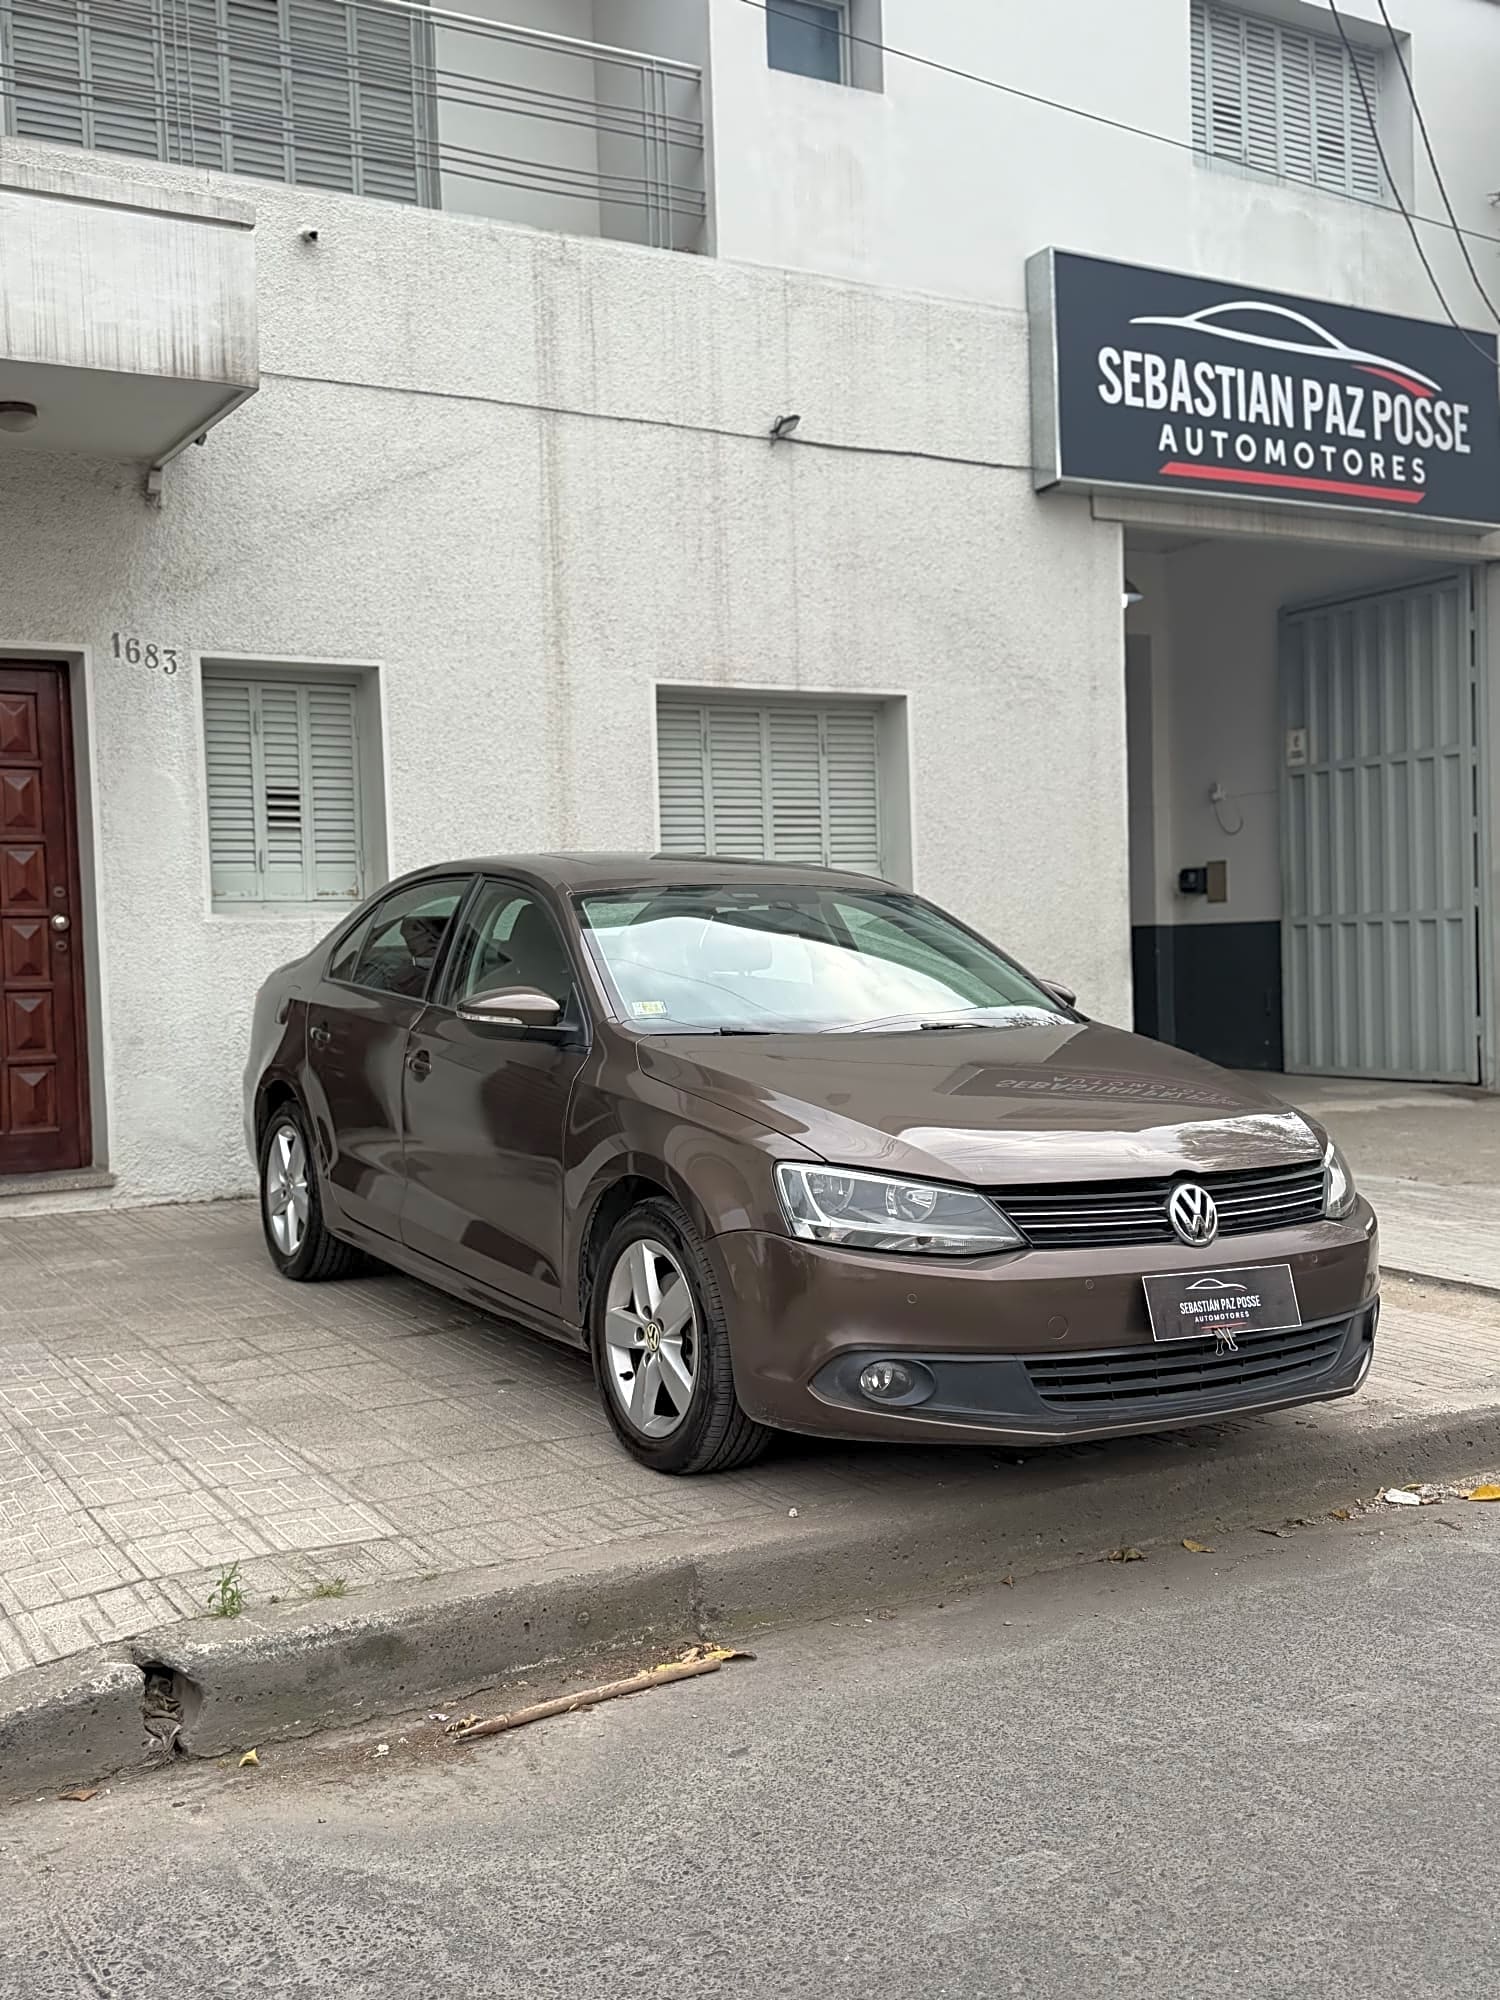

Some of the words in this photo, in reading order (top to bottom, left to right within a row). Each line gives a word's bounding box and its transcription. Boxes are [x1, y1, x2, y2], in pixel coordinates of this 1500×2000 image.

[1098, 346, 1294, 428] SEBASTIAN
[1302, 378, 1366, 438] PAZ
[1372, 390, 1471, 454] POSSE
[1158, 423, 1426, 484] AUTOMOTORES
[111, 632, 177, 675] 1683
[1194, 1310, 1250, 1323] AUTOMOTORES
[1221, 1297, 1236, 1310] PAZ
[1237, 1295, 1261, 1308] POSSE
